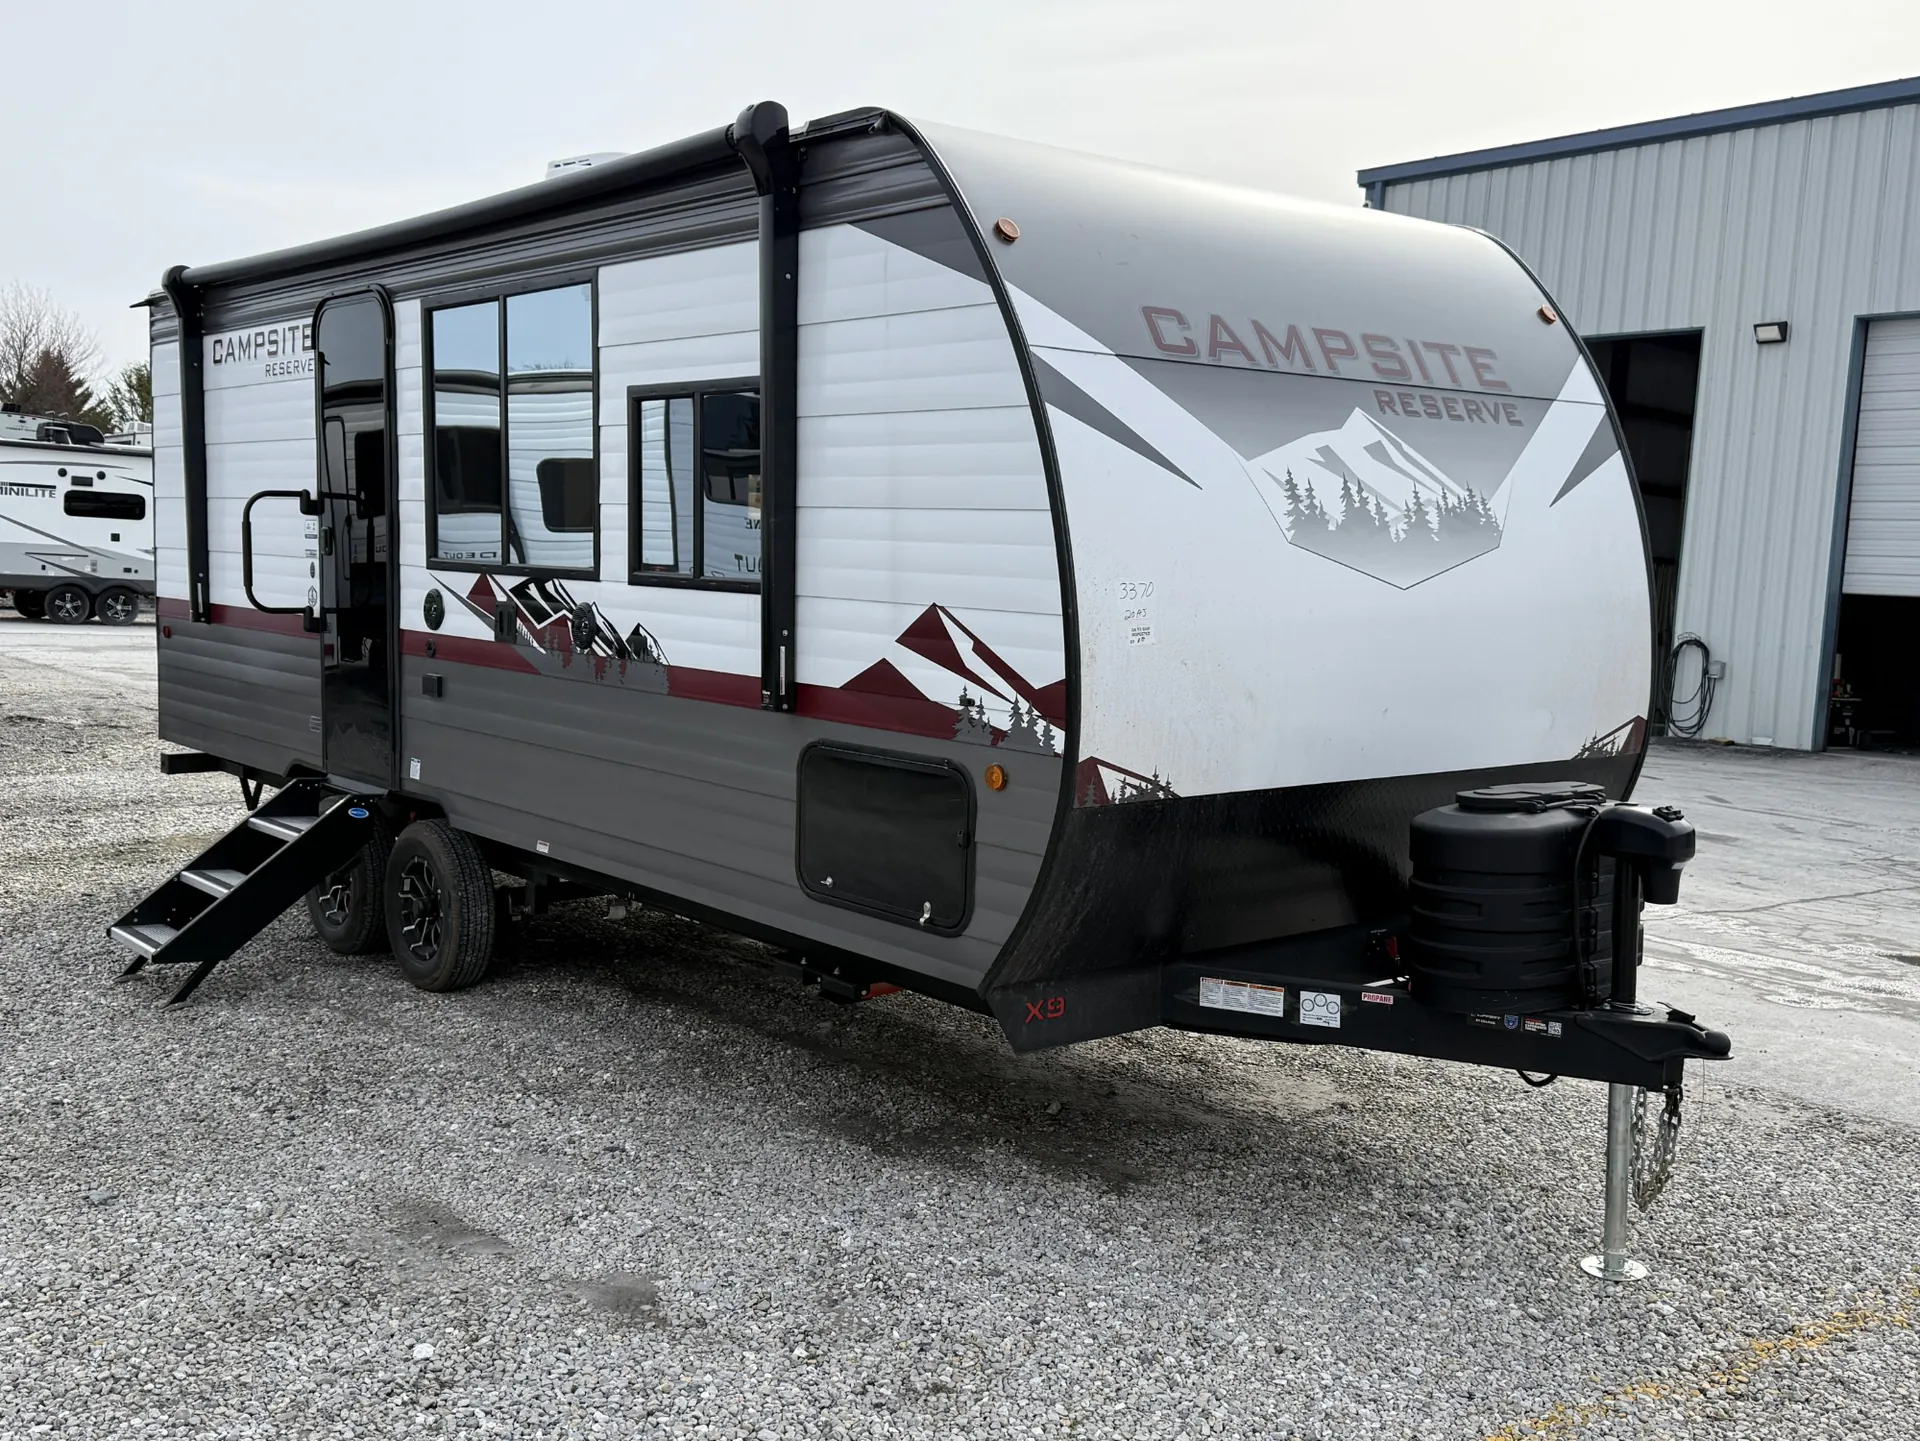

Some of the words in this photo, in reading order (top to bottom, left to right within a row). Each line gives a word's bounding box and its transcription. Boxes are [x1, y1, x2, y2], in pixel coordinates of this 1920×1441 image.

[213, 323, 312, 364] CAMPSITE
[1141, 305, 1511, 391] CAMPSITE
[265, 358, 314, 378] RESERVE
[1373, 389, 1524, 427] RESERVE
[1119, 581, 1155, 600] 3370
[1025, 996, 1065, 1024] X9
[1363, 993, 1392, 1004] PROPANE
